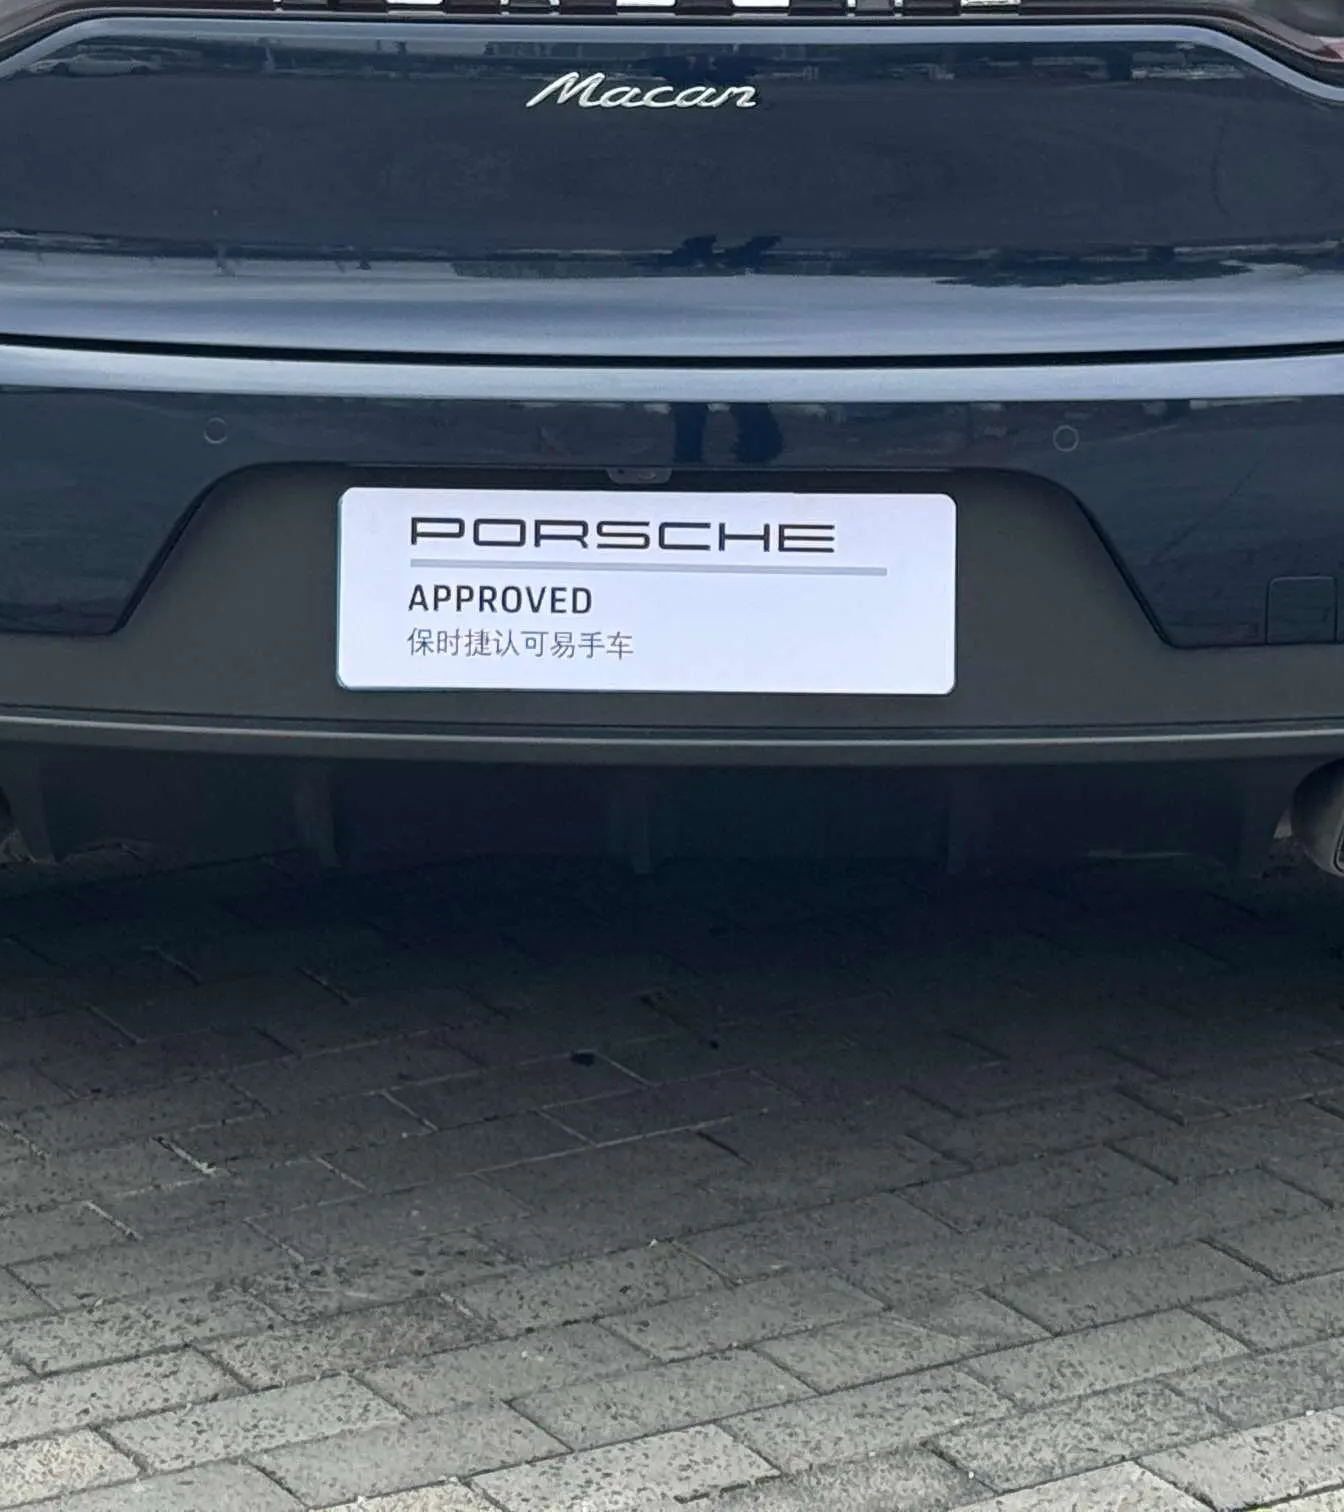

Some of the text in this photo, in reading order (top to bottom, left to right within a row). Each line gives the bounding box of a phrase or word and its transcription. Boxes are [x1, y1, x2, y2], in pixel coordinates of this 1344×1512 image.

[525, 71, 758, 109] Macan
[410, 516, 836, 553] PORSCHE
[408, 584, 593, 614] APPROVED
[406, 627, 634, 661] 保时捷认可易手车
